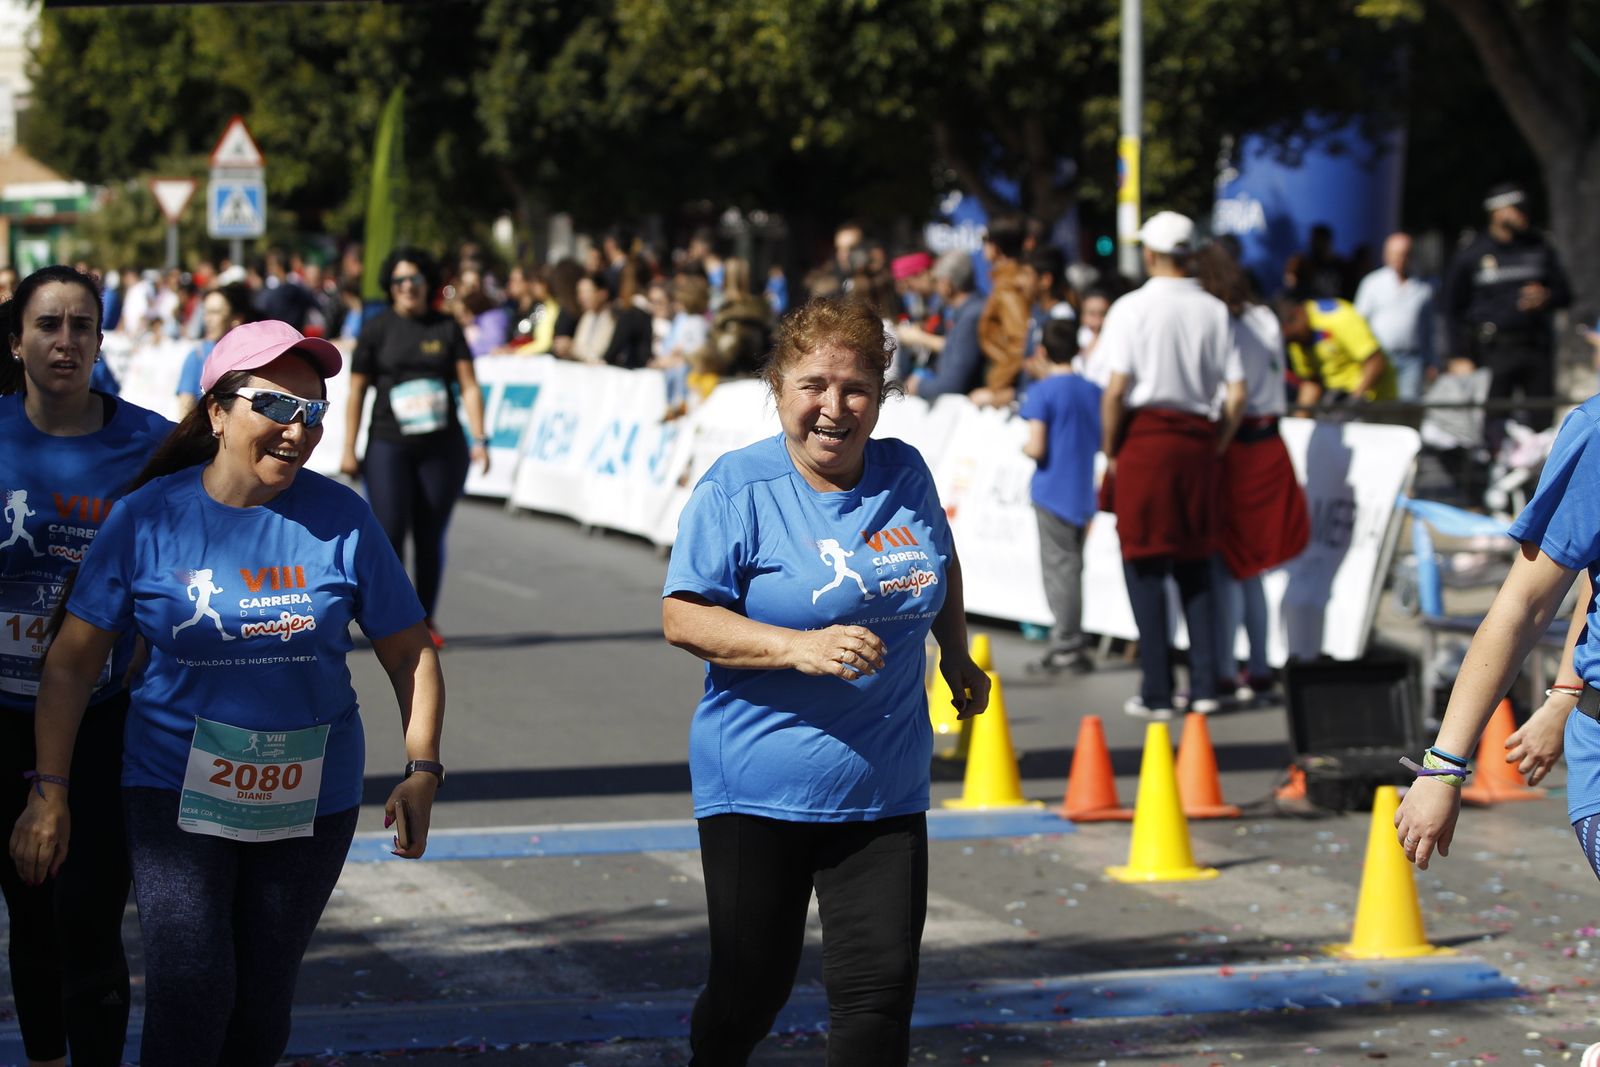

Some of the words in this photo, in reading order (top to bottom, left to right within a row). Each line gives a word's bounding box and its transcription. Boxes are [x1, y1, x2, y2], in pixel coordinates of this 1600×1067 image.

[861, 526, 918, 552] VIII
[872, 551, 928, 566] CARRERA
[240, 566, 306, 592] VIII
[239, 593, 312, 609] CARRERA
[881, 614, 920, 622] NUESTRA
[248, 656, 291, 665] NUESTRA
[266, 734, 286, 742] VIII
[209, 759, 302, 792] 2080
[237, 791, 272, 800] DIANIS
